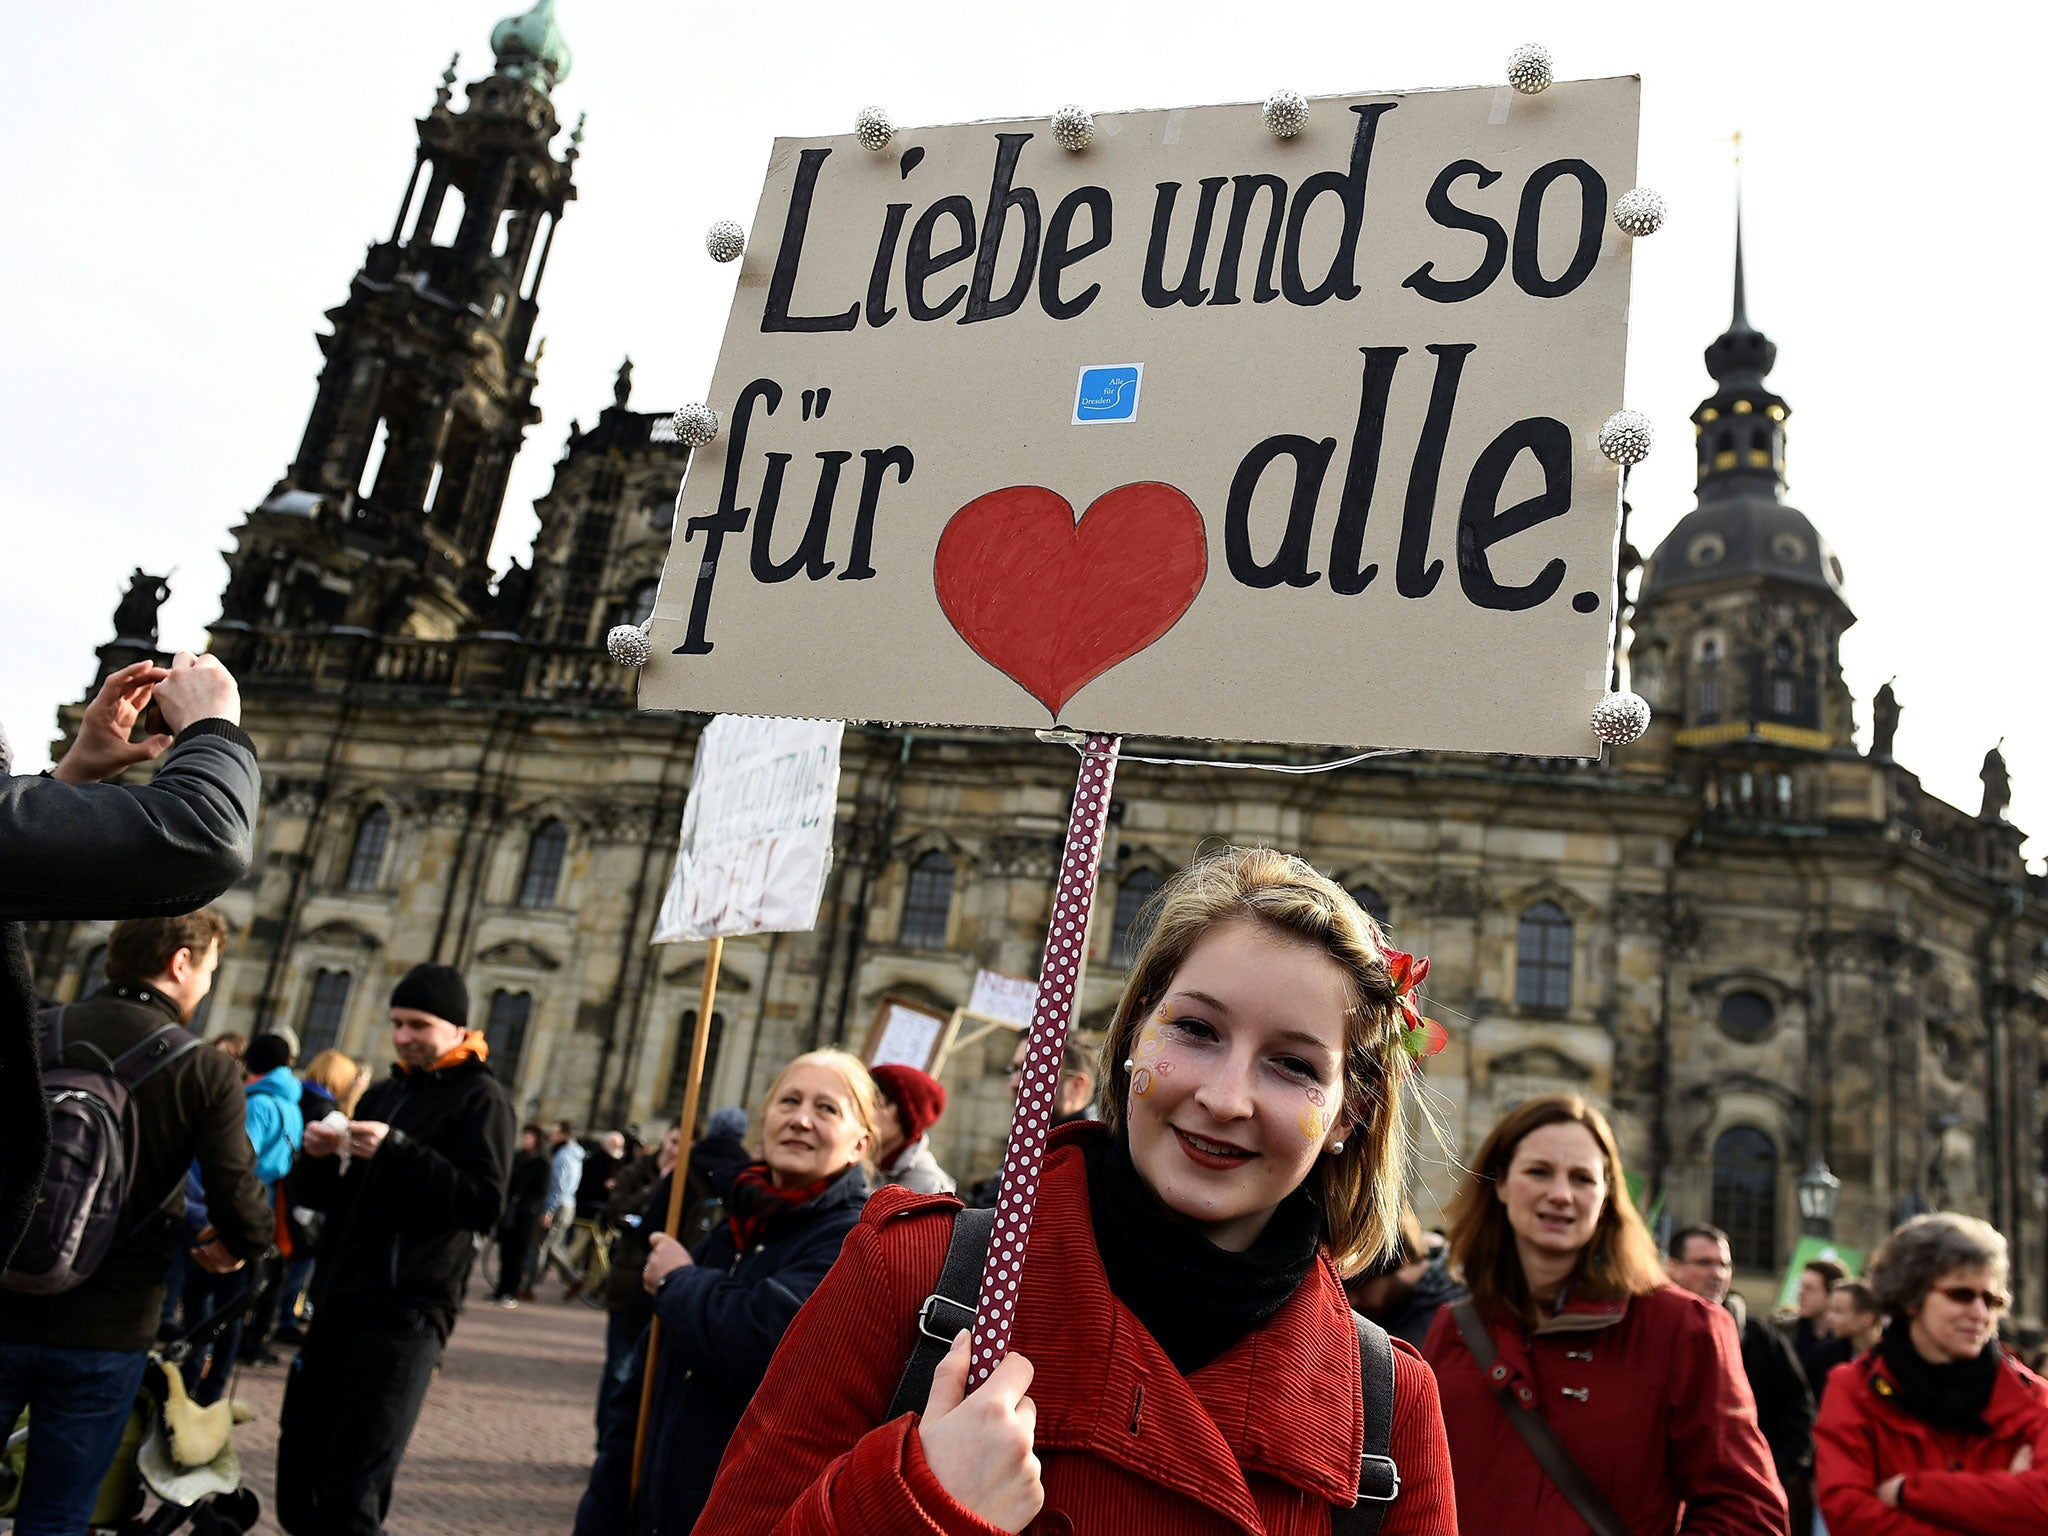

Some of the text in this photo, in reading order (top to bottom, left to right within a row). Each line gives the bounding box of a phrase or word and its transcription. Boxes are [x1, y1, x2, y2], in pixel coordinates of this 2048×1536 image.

[760, 103, 1607, 333] Liebe und so
[1081, 397, 1111, 405] Dresden
[1103, 387, 1115, 395] für
[672, 344, 1599, 654] für alle.
